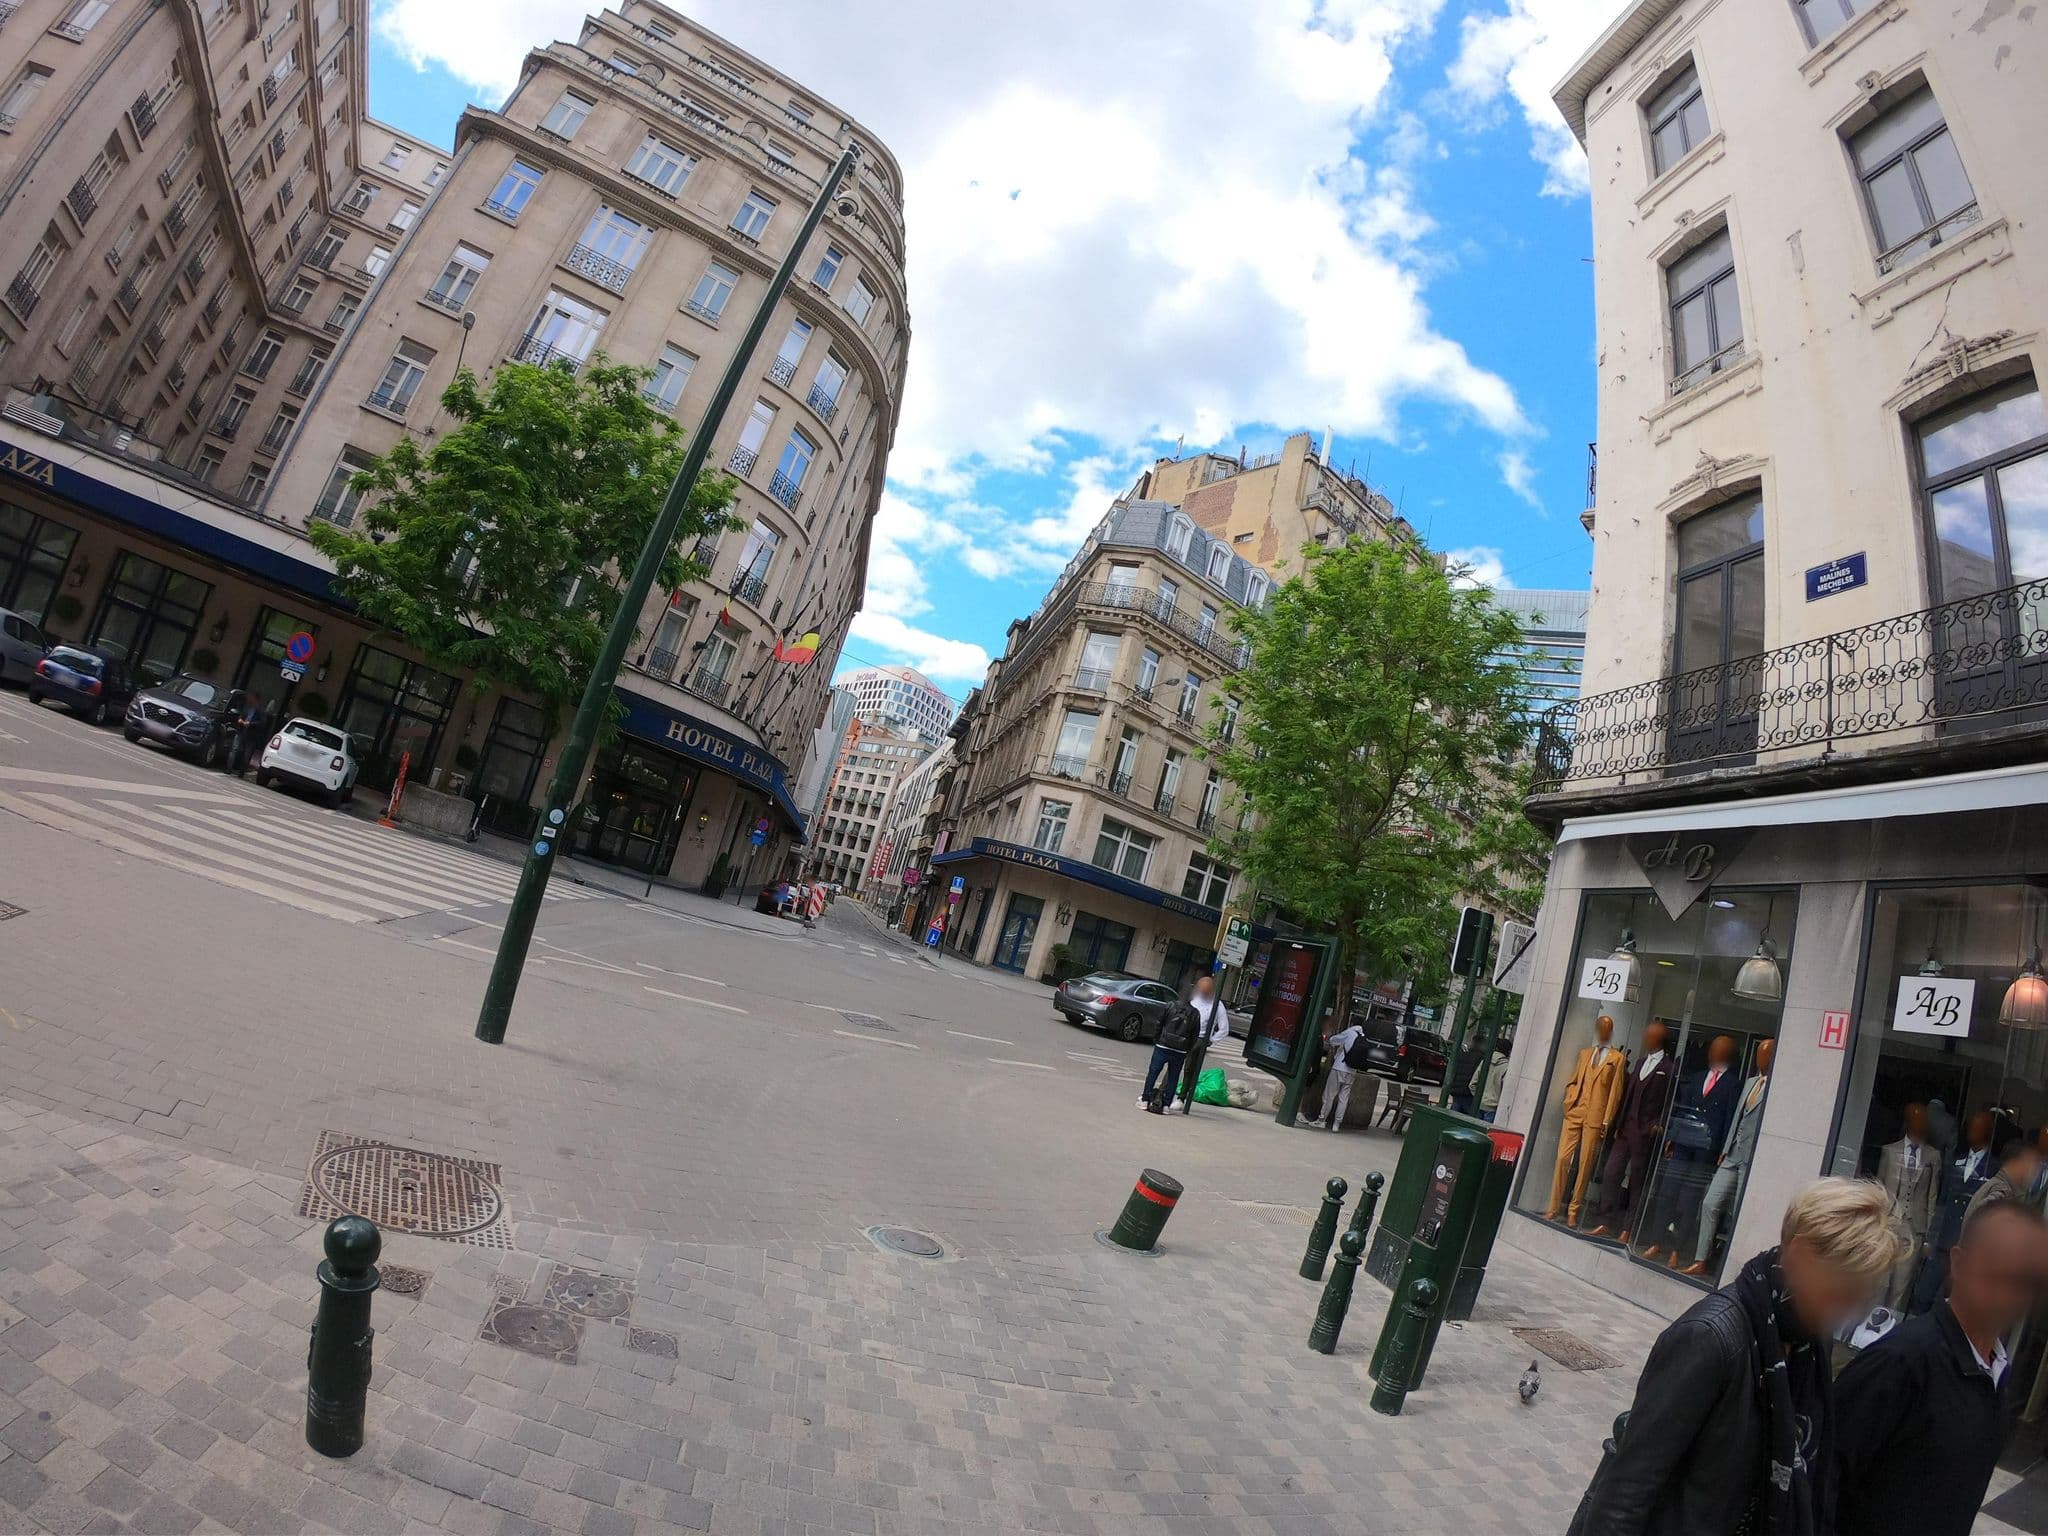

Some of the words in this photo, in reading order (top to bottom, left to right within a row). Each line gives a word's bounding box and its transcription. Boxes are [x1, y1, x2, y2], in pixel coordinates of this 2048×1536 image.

[1817, 575, 1855, 592] MECHELSE
[1820, 567, 1851, 583] MALINES
[665, 719, 735, 763] HOTEL
[740, 750, 775, 783] PLAZA
[986, 843, 1019, 860] HOTEL
[1022, 851, 1060, 871] PLAZA
[1512, 924, 1531, 937] ZONE
[1587, 965, 1621, 995] AB
[1906, 986, 1962, 1027] AB
[1824, 1016, 1844, 1044] H
